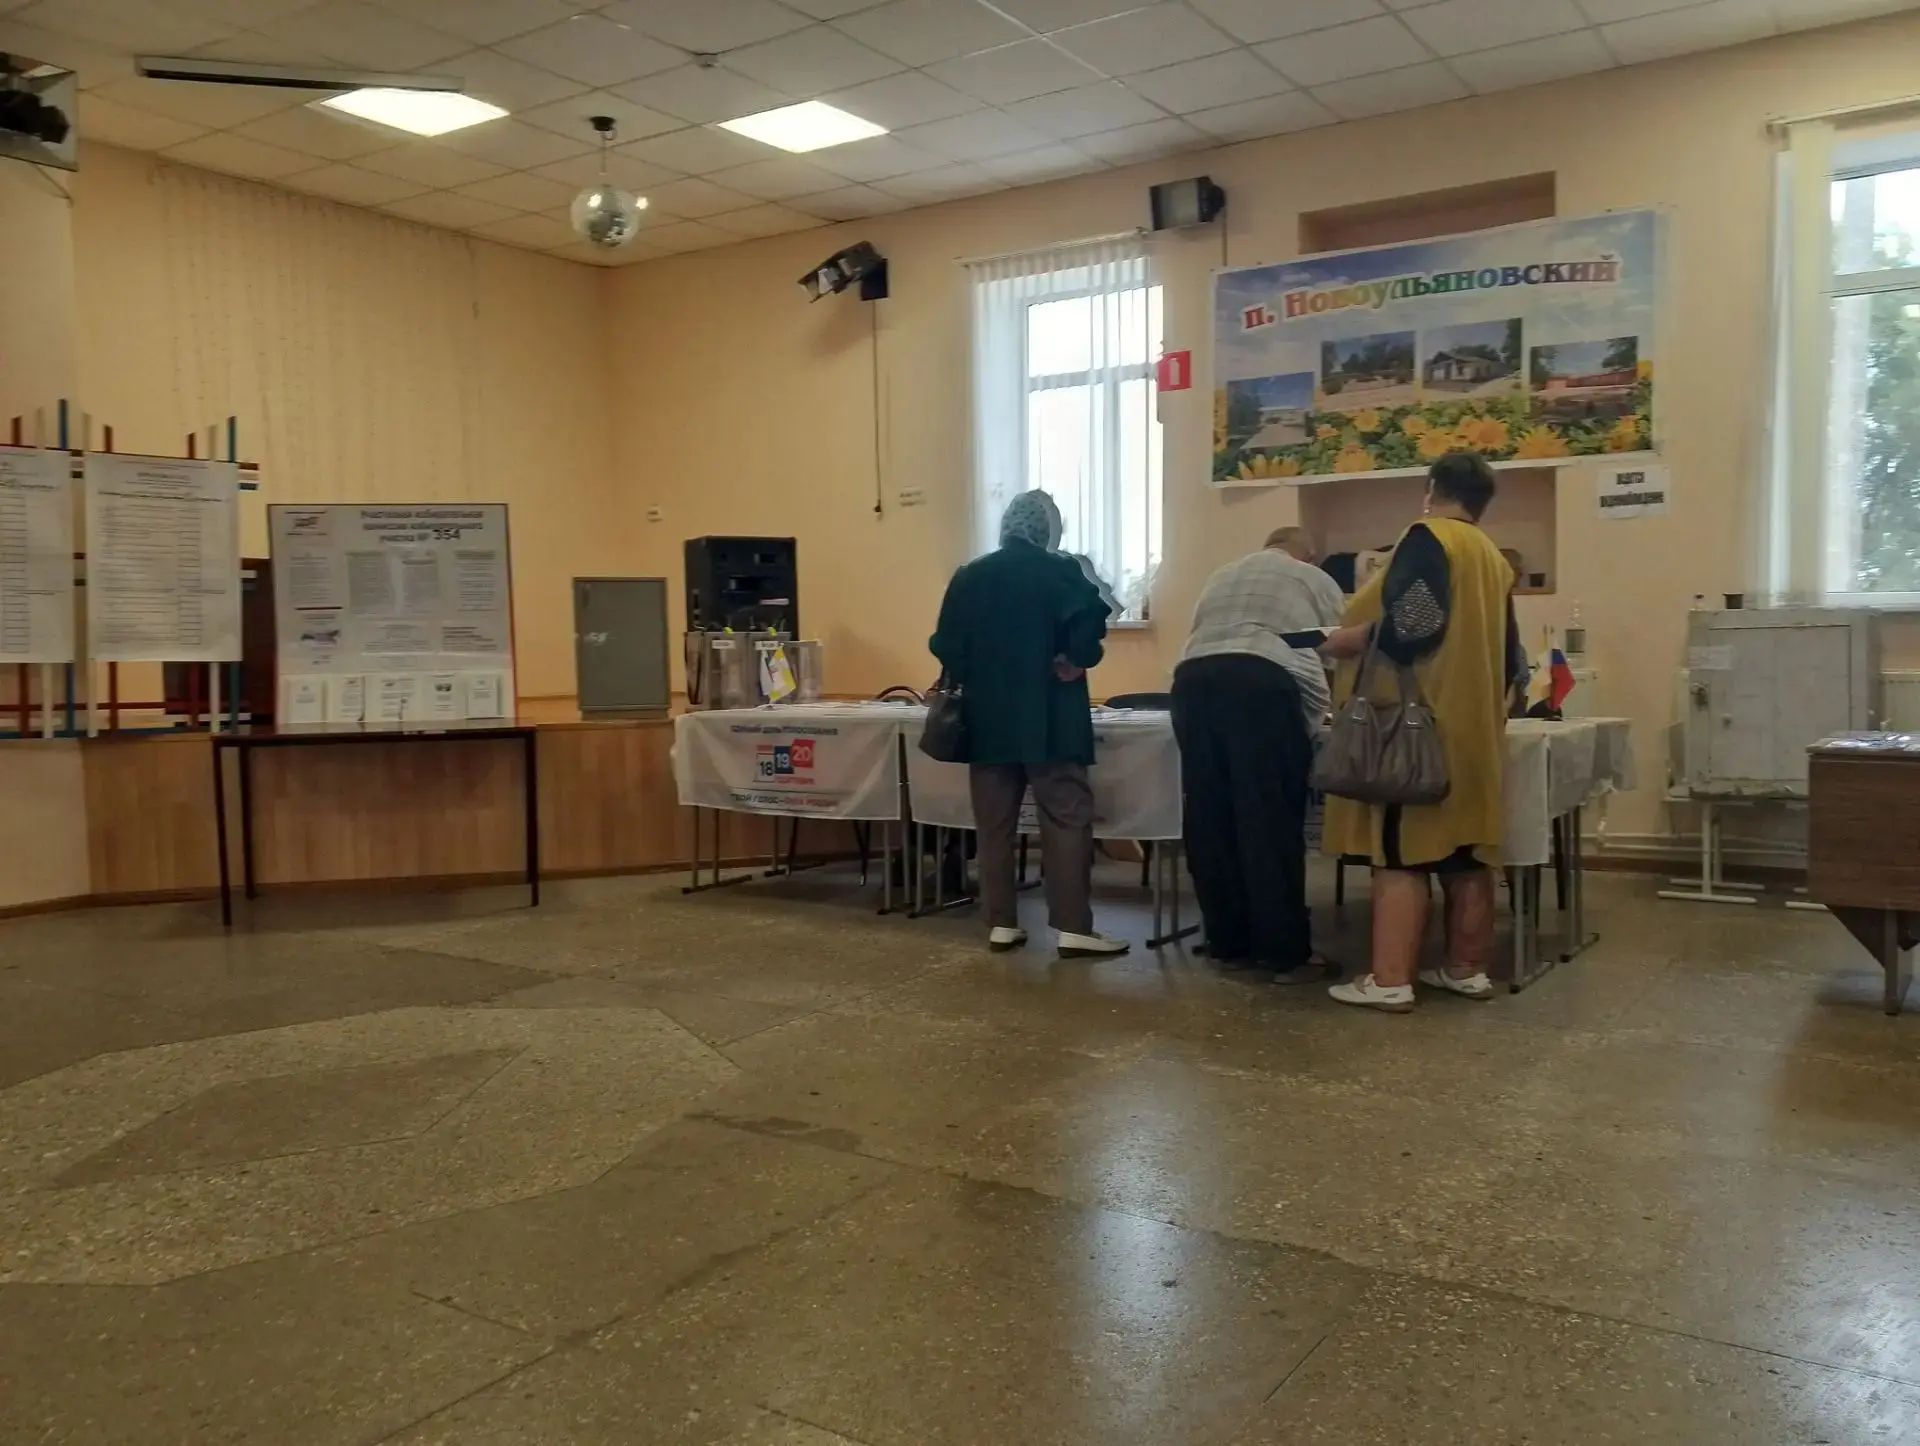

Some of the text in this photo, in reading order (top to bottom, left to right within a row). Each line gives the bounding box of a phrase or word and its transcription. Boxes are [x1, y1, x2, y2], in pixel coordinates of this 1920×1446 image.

[1244, 254, 1619, 329] п. Новоульяновский
[432, 528, 461, 541] 354
[760, 761, 775, 777] 18
[776, 752, 790, 769] 19
[792, 744, 812, 763] 20
